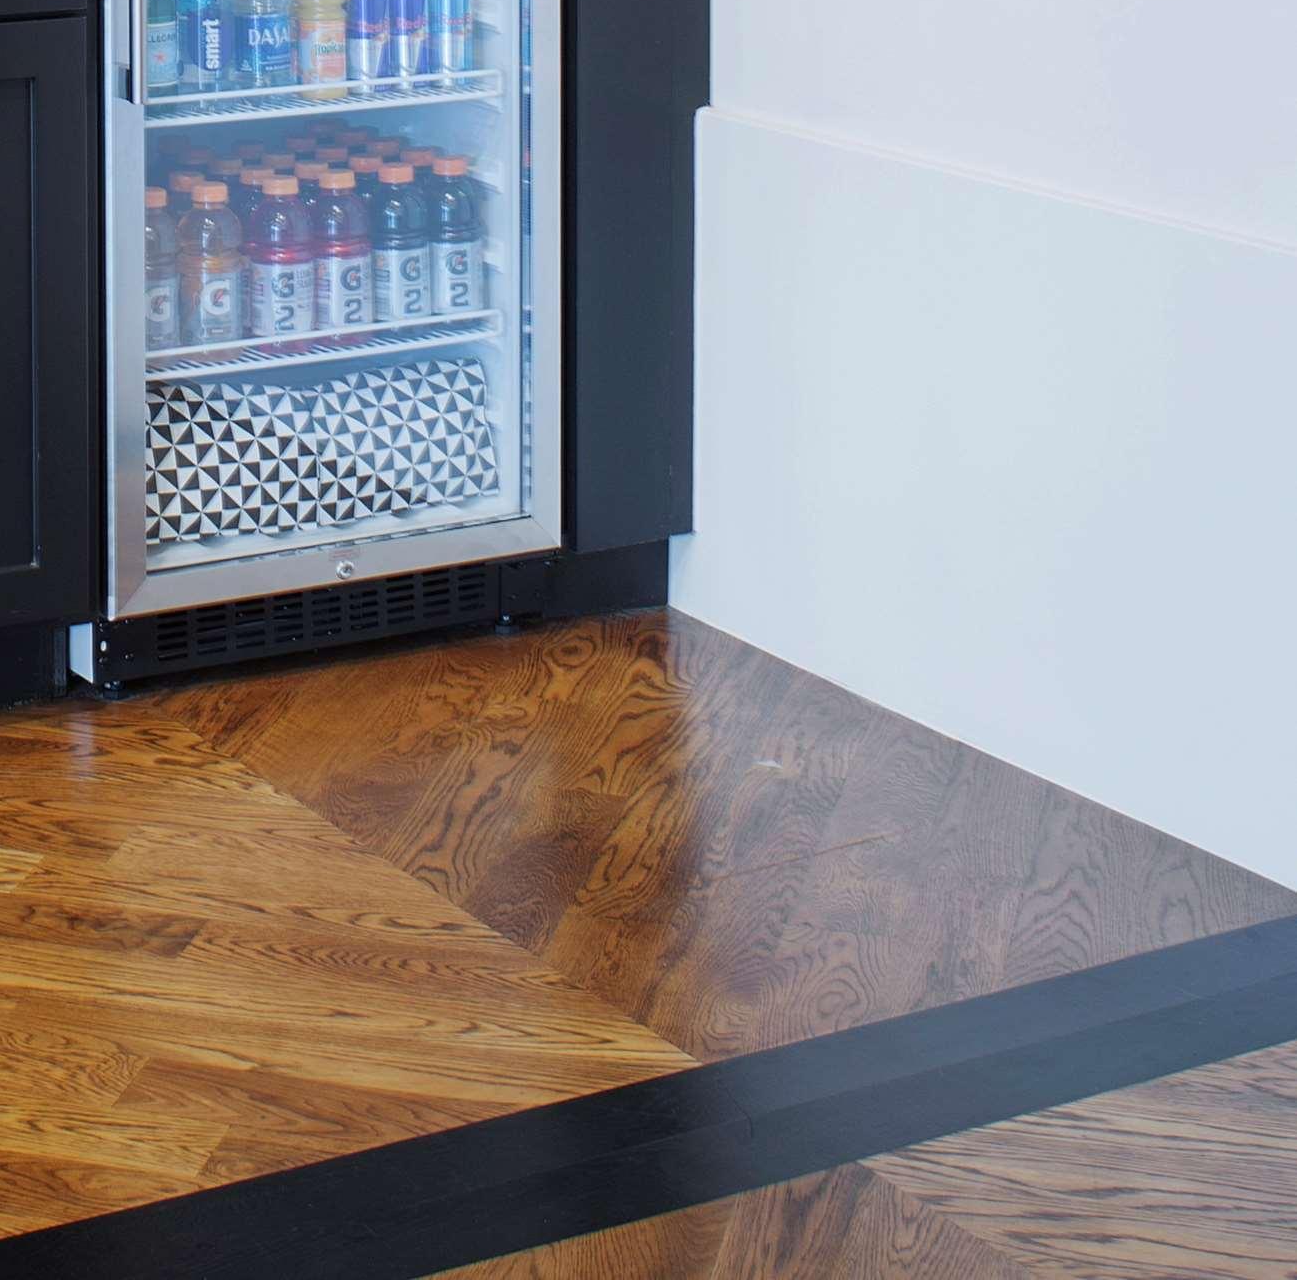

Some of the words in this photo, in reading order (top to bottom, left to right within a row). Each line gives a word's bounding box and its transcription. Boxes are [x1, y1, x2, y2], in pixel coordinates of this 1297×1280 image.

[201, 18, 220, 70] smart
[404, 288, 422, 314] 2
[450, 281, 469, 307] 2
[275, 304, 294, 331] 2
[343, 297, 362, 324] 2
